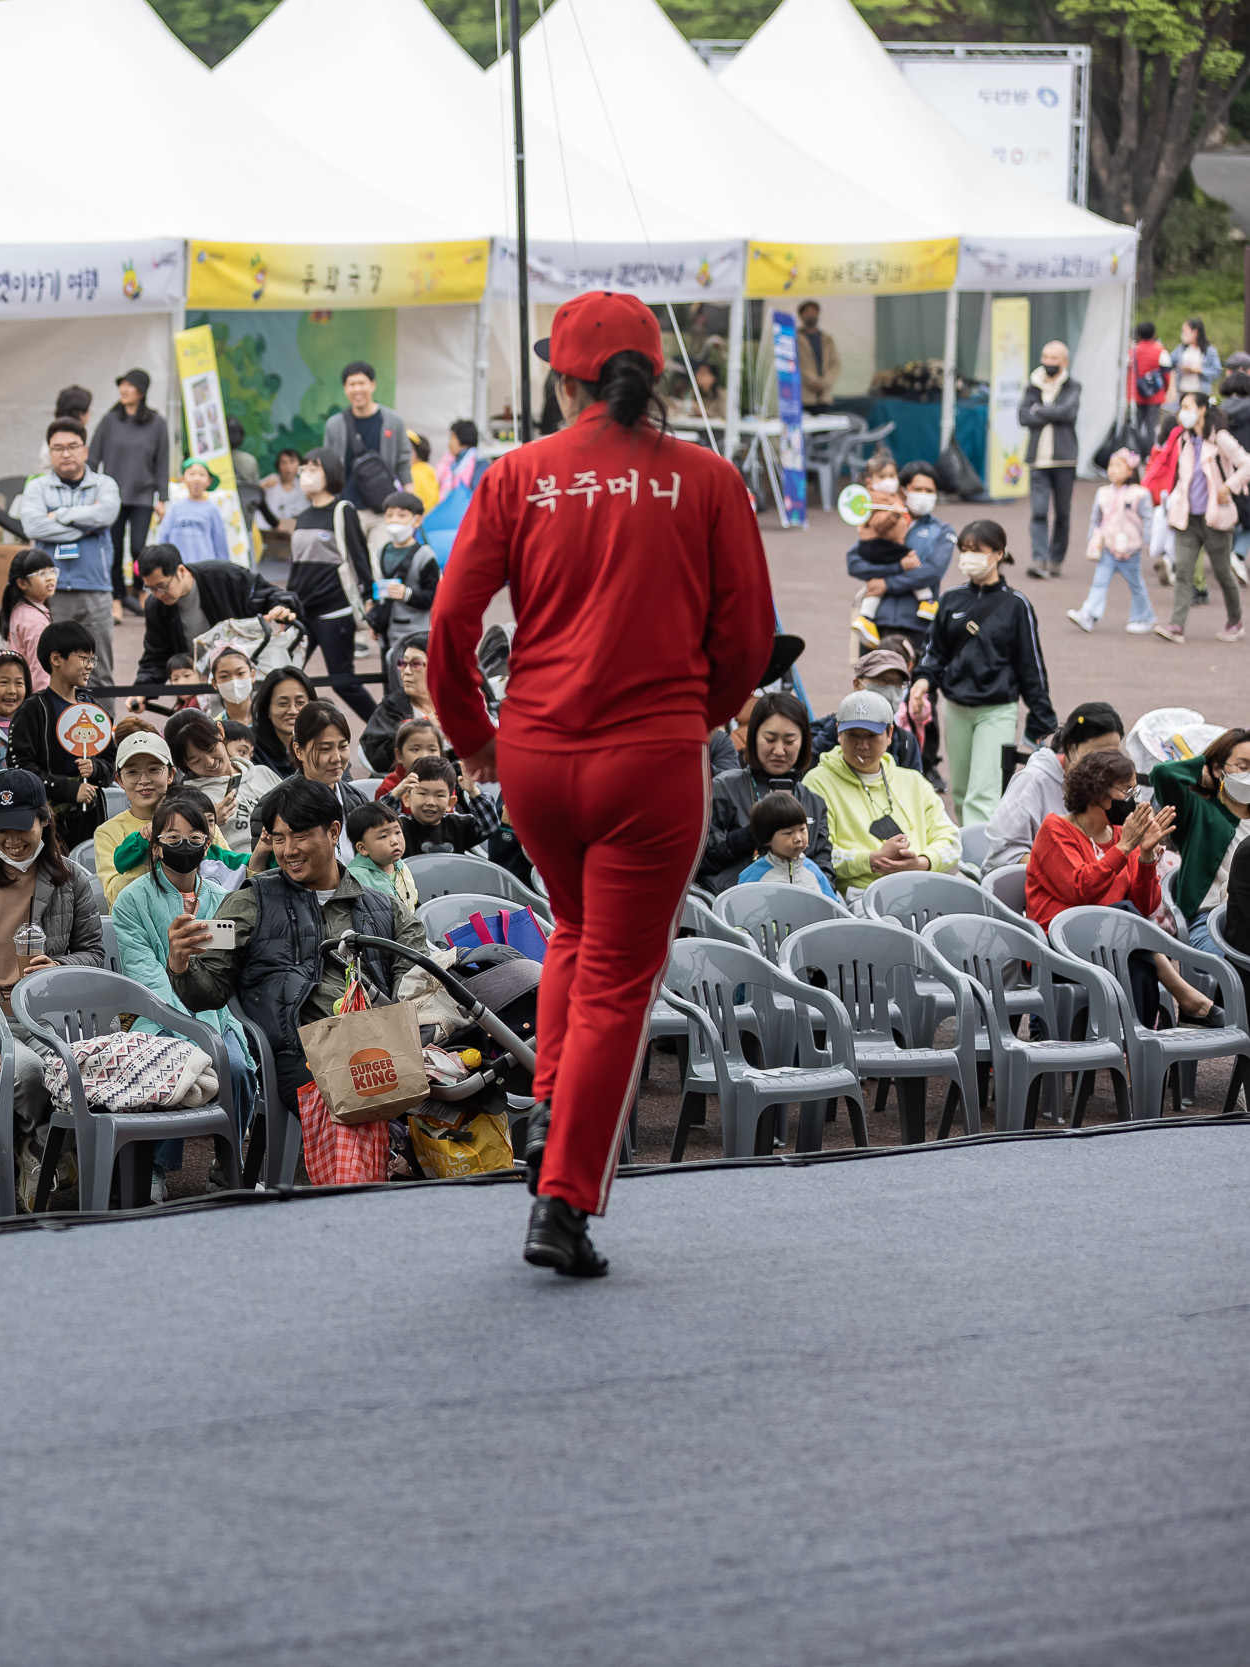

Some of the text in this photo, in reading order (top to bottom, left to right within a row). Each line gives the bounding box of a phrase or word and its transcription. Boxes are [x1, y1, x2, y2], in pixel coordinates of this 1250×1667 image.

[525, 468, 681, 514] 복주머니
[350, 1059, 395, 1076] BURGER
[353, 1069, 398, 1090] KING
